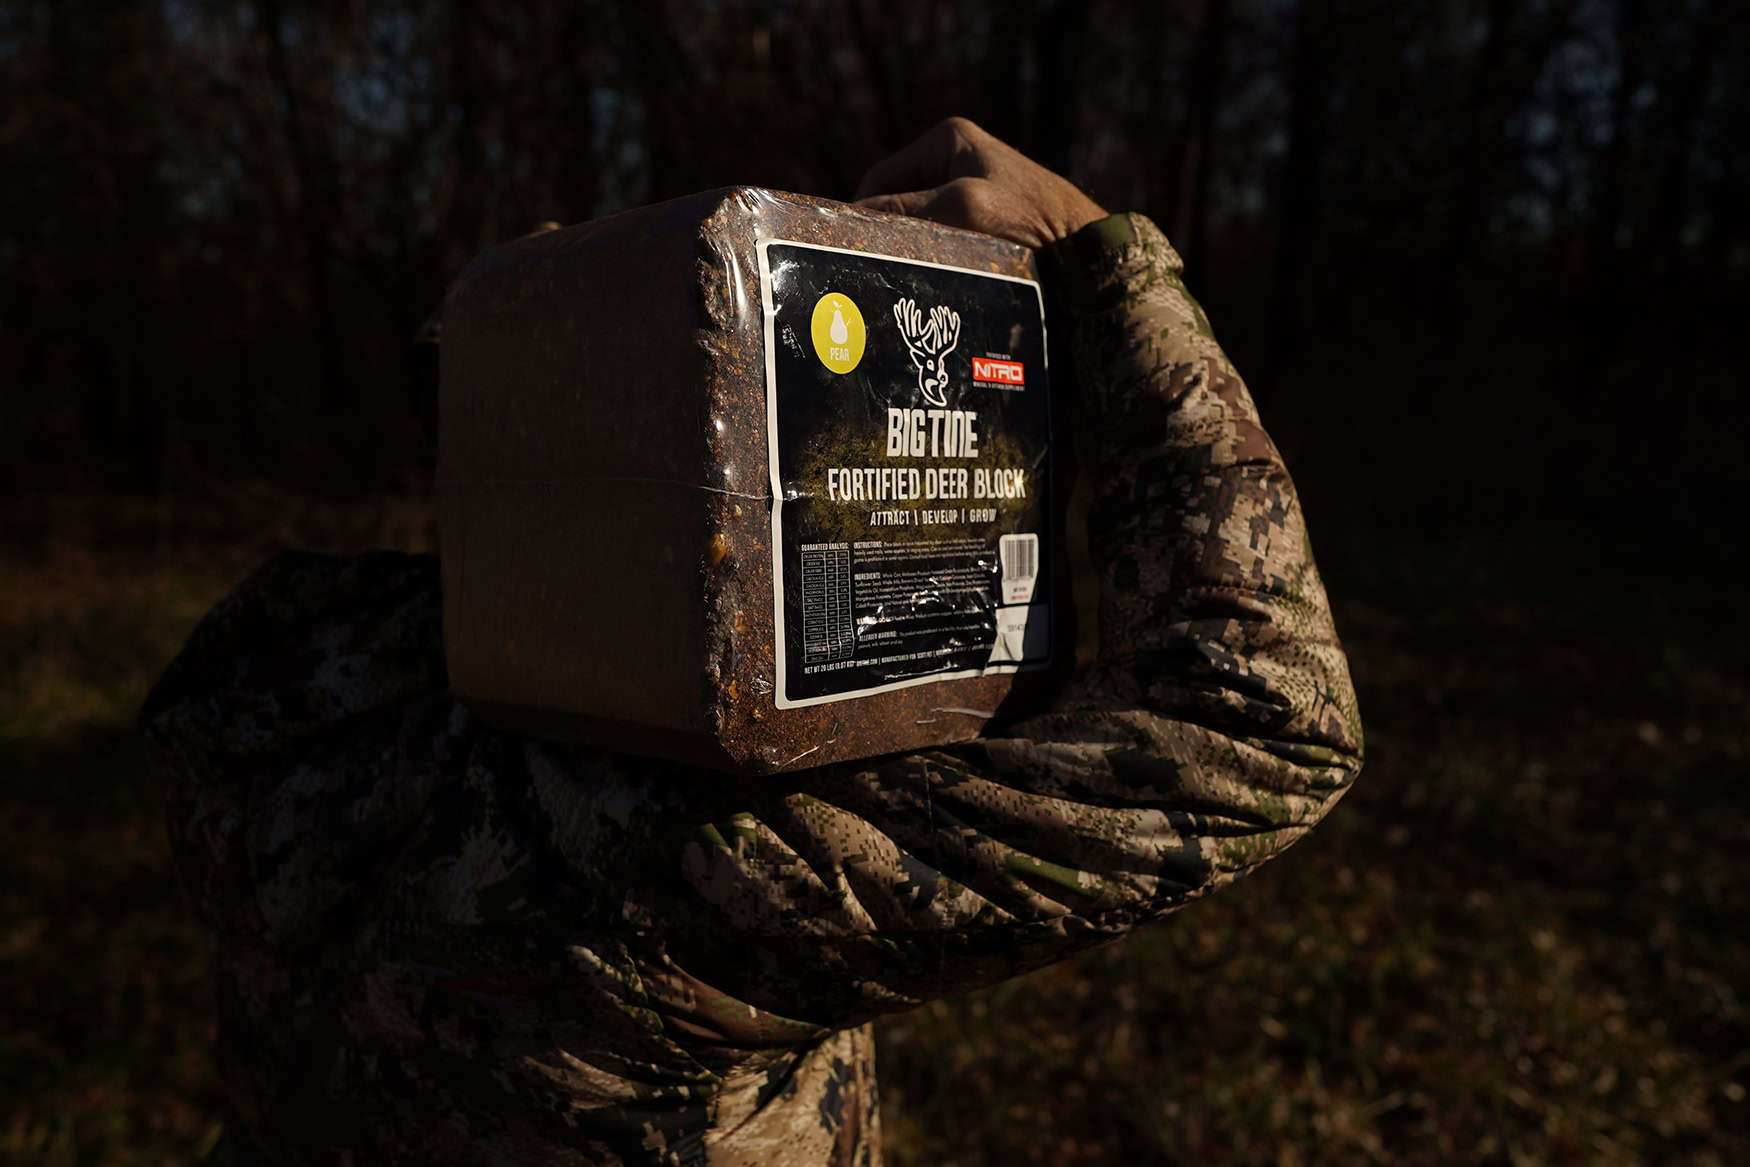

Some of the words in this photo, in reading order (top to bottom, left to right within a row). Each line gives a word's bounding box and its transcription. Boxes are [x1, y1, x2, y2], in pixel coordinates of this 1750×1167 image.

[830, 347, 850, 361] PEAR
[975, 361, 1023, 381] NITRO
[828, 468, 920, 501] FORTIFIED
[925, 468, 968, 499] DEER
[974, 468, 1026, 499] BLOCK
[870, 510, 910, 526] ATTRACT
[922, 509, 957, 524] DEVELOP
[970, 508, 997, 523] GROW
[801, 543, 828, 551] GUARANTEED
[804, 666, 813, 674] NET
[820, 664, 826, 672] 20
[827, 663, 835, 671] LBS
